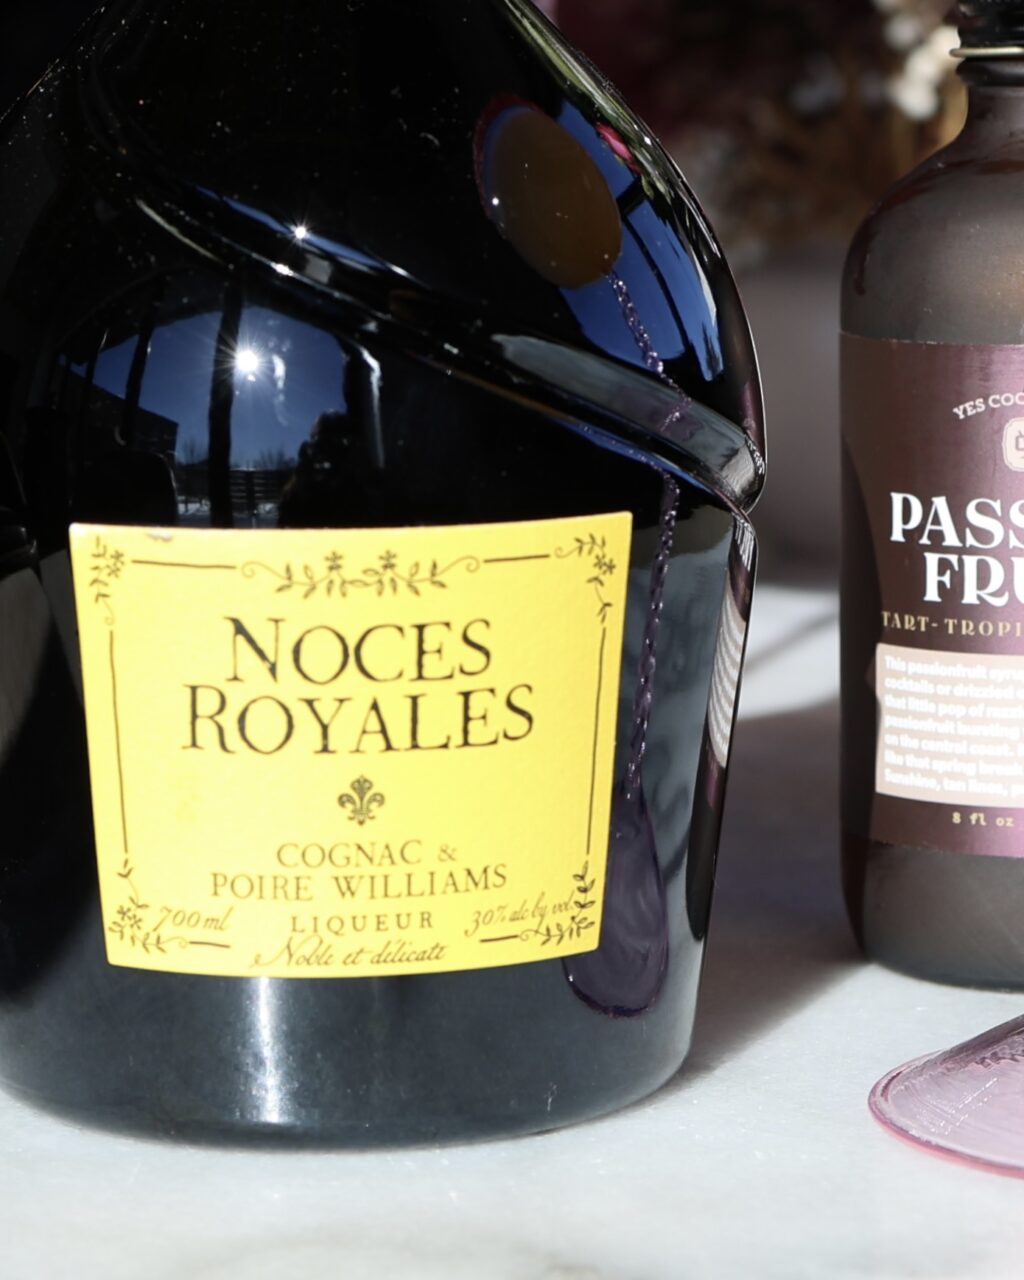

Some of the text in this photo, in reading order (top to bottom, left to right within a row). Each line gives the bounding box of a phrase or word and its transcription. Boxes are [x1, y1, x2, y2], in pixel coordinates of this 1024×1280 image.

[952, 398, 986, 420] YES
[223, 616, 492, 685] NOCES
[182, 683, 534, 755] ROYALES
[952, 811, 962, 824] 8
[969, 812, 987, 826] fl
[995, 816, 1014, 827] oz
[277, 839, 458, 868] COGNAC &
[211, 864, 507, 901] POIRE WILLIAMS
[152, 906, 234, 932] 700 ml
[291, 911, 433, 936] LIQUEUR
[464, 903, 508, 938] 30%
[249, 935, 335, 969] Noble
[343, 947, 372, 966] et
